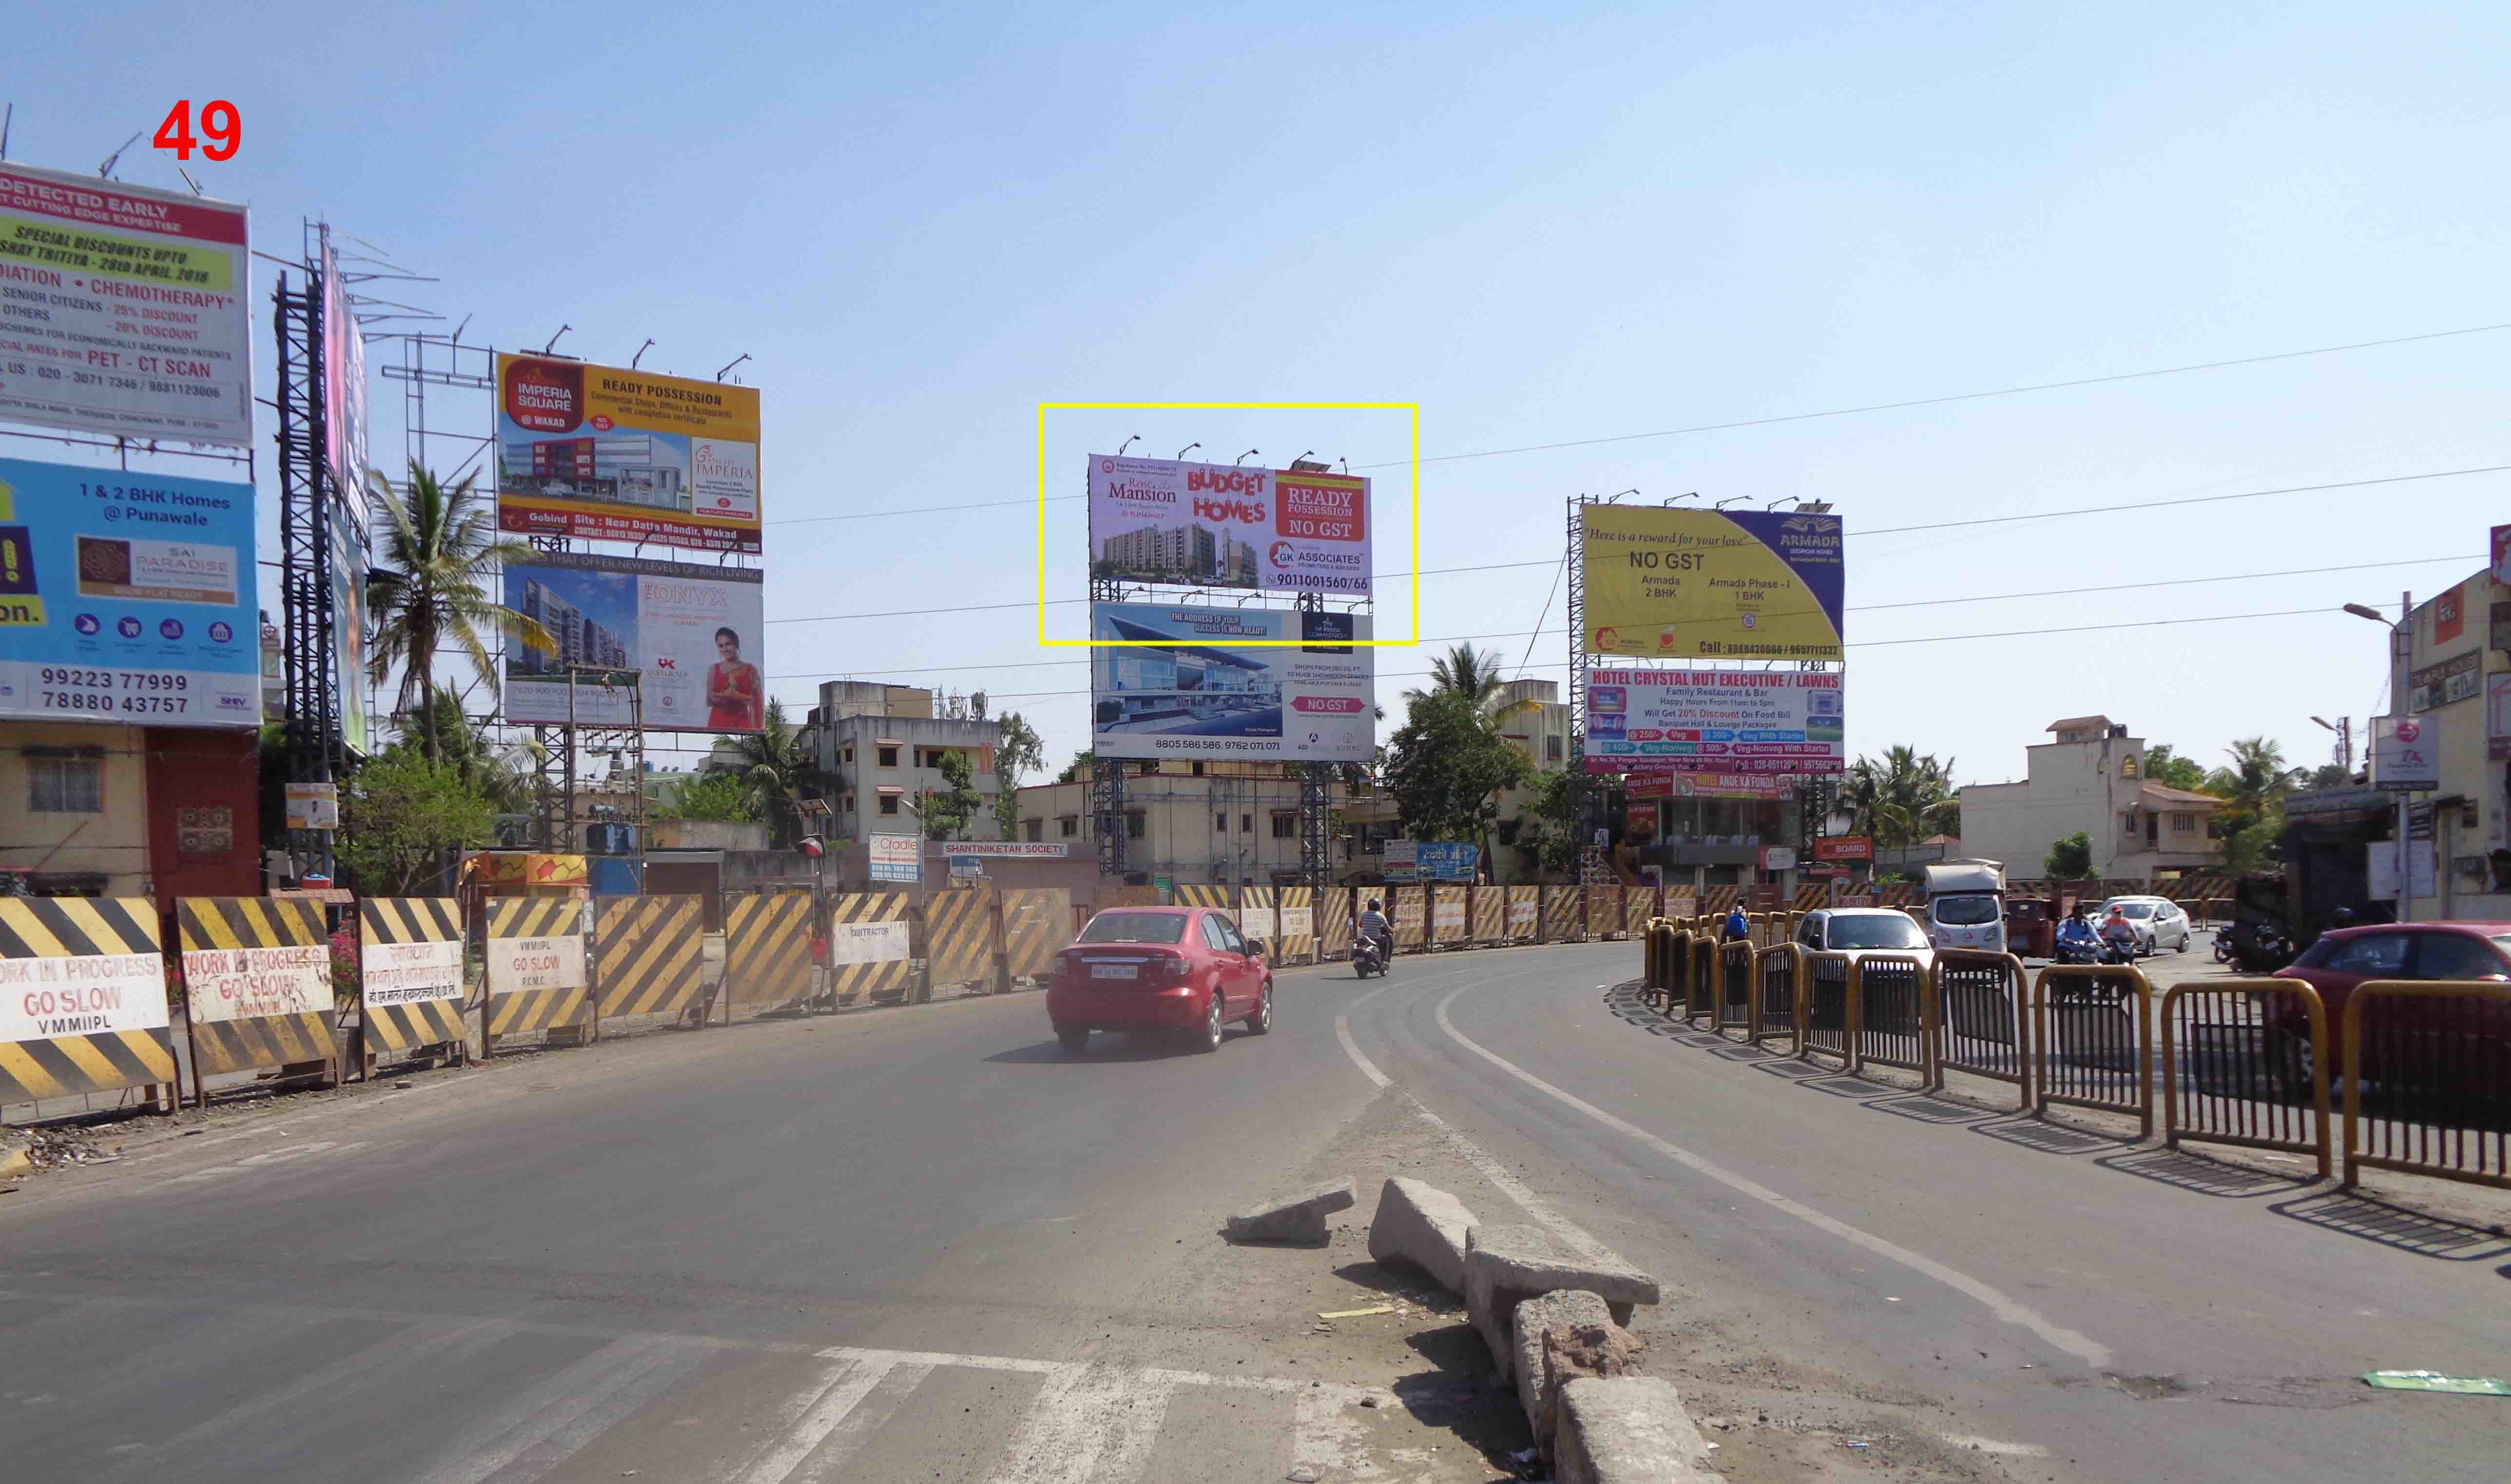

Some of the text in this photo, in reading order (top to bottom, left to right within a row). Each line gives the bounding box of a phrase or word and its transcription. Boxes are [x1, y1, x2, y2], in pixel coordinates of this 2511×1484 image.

[0, 178, 168, 218] DETECTED EARLY
[12, 196, 70, 214] CUTTING
[74, 207, 110, 221] EDGE
[113, 213, 180, 231] EXPERTISE
[15, 226, 70, 247] SPECIAL
[74, 236, 151, 259] DISCOUNTS
[133, 263, 172, 279] APRIL
[3, 287, 197, 324] SENIOR CITIZENS DISCOUNT
[3, 304, 197, 340] OTHERS DISCOUNT
[191, 347, 232, 361] PATIENTS
[87, 350, 211, 378] PET CT SCAN
[8, 361, 102, 386] US 020 3071
[518, 382, 572, 400] IMPERIA
[602, 379, 721, 405] READY POSSESSION
[518, 395, 571, 412] SQUARE
[522, 415, 565, 428] @ WAKAD
[697, 463, 753, 479] IMPERIA
[1188, 468, 1266, 496] BUDGET
[80, 483, 231, 510] 1 & 2 BHK Homes
[1108, 482, 1177, 503] Mansion
[1287, 487, 1353, 507] READY
[104, 506, 208, 526] @ Punawale
[1130, 511, 1165, 520] PUNAWALE
[1194, 498, 1266, 523] HOMES
[1288, 503, 1352, 516] POSSESSION
[530, 513, 567, 523] Gobind
[575, 514, 595, 525] Site
[606, 517, 630, 528] Near
[664, 523, 700, 536] Mandir,
[703, 527, 736, 539] Wakad
[1288, 520, 1352, 537] NO GST
[1618, 530, 1720, 547] is a reward for your
[1780, 534, 1841, 546] ARMADA
[136, 556, 229, 572] PARADISE
[553, 555, 759, 578] THAT OFFER NEW LEVELS OF RICH LIVING
[1279, 552, 1361, 564] GK ASSOCIATES
[1630, 551, 1704, 570] NO GST
[1277, 574, 1368, 590] 9011001560/66
[1641, 575, 1680, 586] Armada
[1709, 578, 1778, 589] Armada Phase
[655, 584, 728, 607] ONYX
[1645, 588, 1677, 598] 2 BHK
[1742, 591, 1765, 600] BHK
[1171, 613, 1240, 624] THE ADDRESS YOUR
[1194, 624, 1243, 634] SUCCESS NOW
[1700, 640, 1721, 653] Call
[41, 668, 188, 691] 99223 77999
[1593, 670, 1840, 689] HOTEL CRYSTAL HUT EXECUTIVE LAWNS
[1666, 687, 1694, 697] Family
[1697, 688, 1742, 697] Restaurant
[42, 692, 188, 713] 78880 43757
[1307, 699, 1349, 711] NO GST
[1661, 697, 1684, 706] Happy
[1731, 699, 1750, 707] 11am
[1759, 700, 1775, 709] 5pm
[1644, 709, 1660, 718] Will
[1661, 710, 1676, 718] Get
[1678, 710, 1698, 718] 20%
[1700, 709, 1739, 718] Discount
[1659, 720, 1689, 729] Banquet
[1714, 721, 1740, 730] Lounge
[1742, 721, 1777, 731] Packages
[1639, 731, 1804, 741] 250/- Veg Veg With Starter
[1156, 740, 1281, 751] 8805 586 9762 071 071
[1645, 744, 1693, 753] Veg-Nonveg
[1737, 745, 1783, 754] Veg-Nonveg
[880, 838, 918, 850] Cradle
[946, 845, 1064, 853] SHANTINIKETAN SOCIETY
[39, 957, 157, 982] IN PROGRESS
[183, 948, 322, 975] WORK PROGRESS
[514, 955, 560, 971] GO SLOW
[220, 975, 296, 999] GO SLOW
[24, 986, 121, 1016] GO SLOW
[38, 1015, 112, 1034] VMMIIPL
